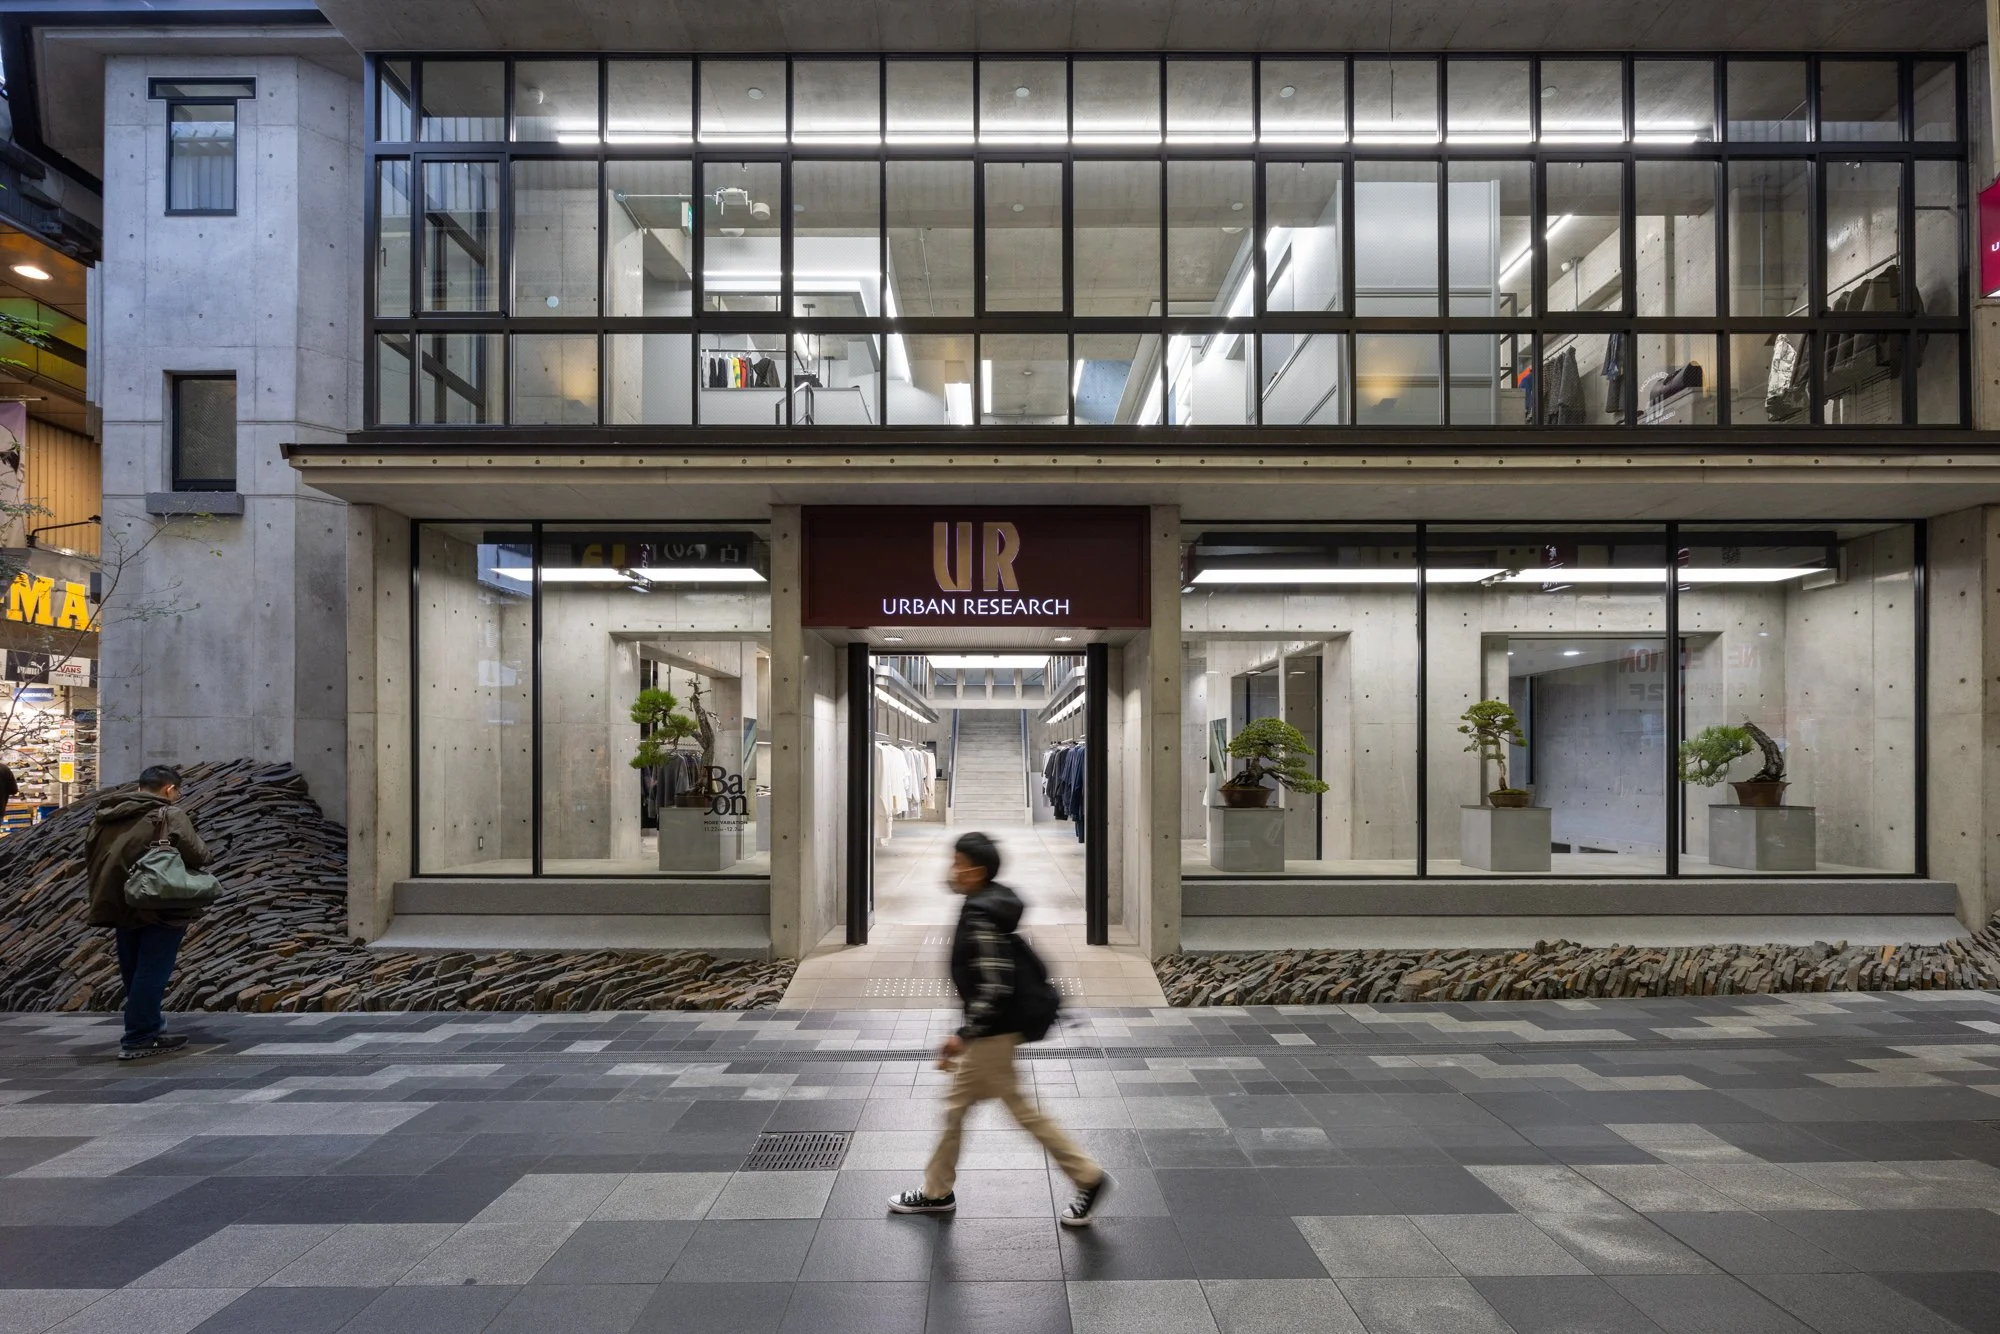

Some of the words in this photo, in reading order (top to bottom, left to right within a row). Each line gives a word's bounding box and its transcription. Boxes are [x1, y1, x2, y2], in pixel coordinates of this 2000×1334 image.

[933, 521, 1021, 591] UR
[6, 571, 101, 633] MA
[883, 598, 956, 615] URBAN
[964, 598, 1070, 615] RESEARCH
[57, 664, 82, 674] VANS
